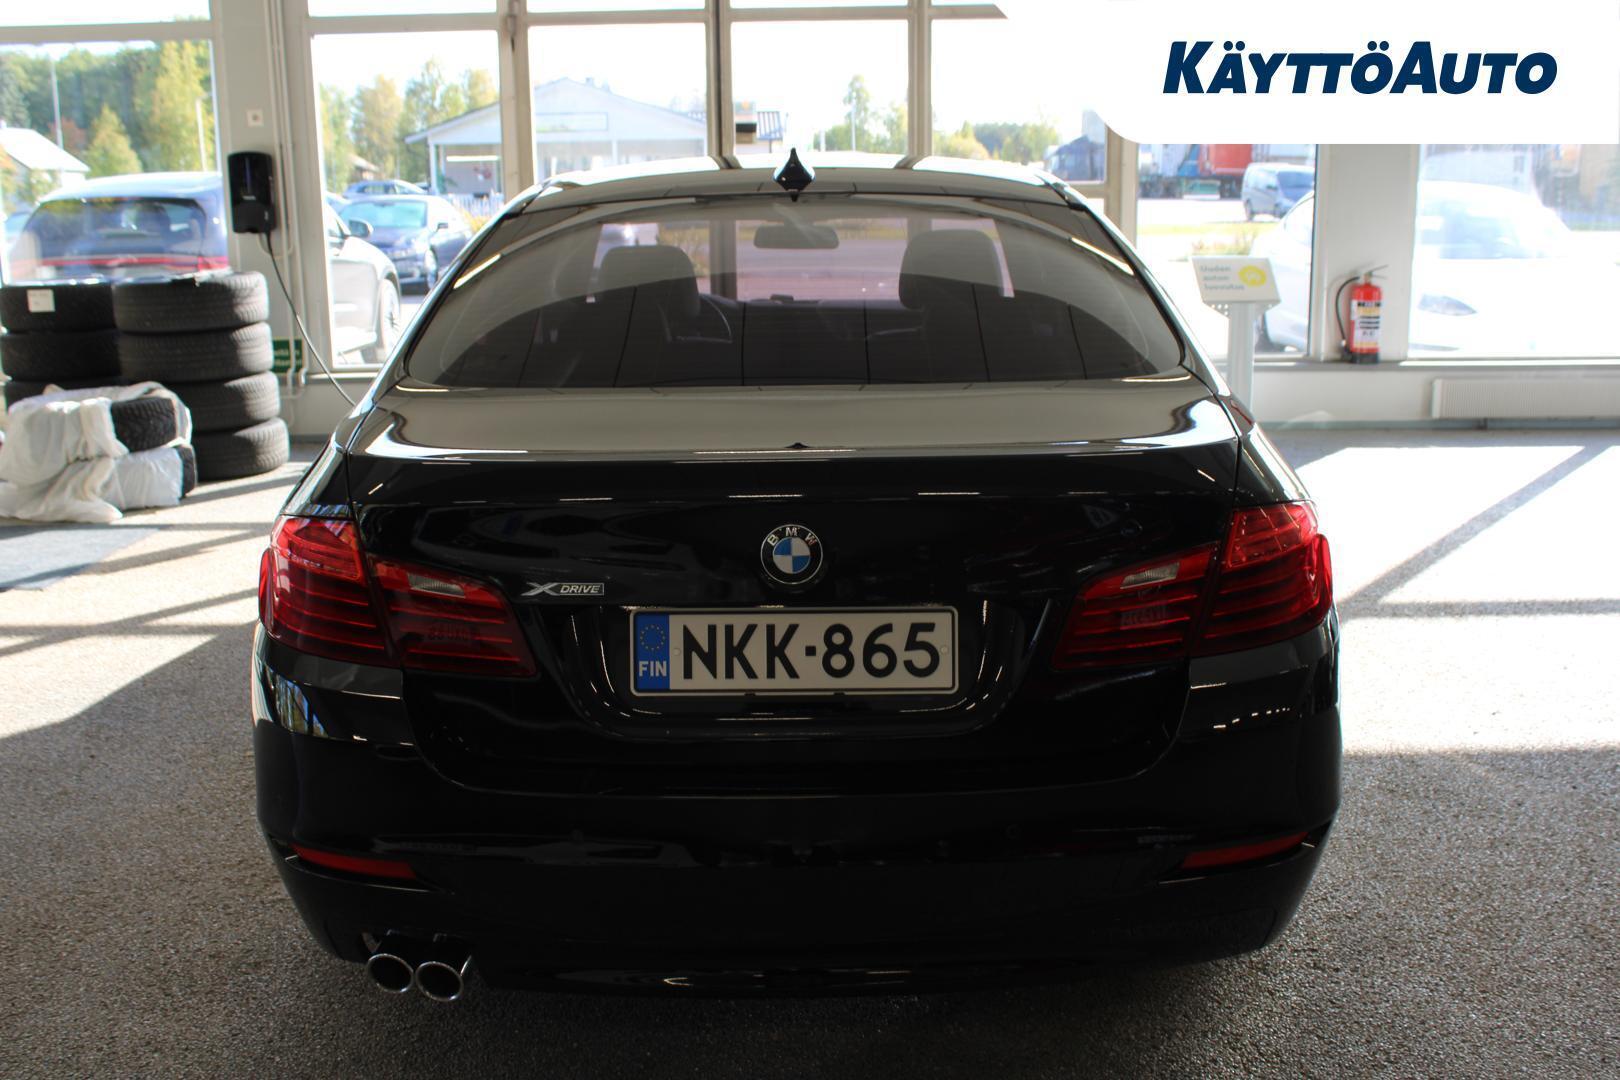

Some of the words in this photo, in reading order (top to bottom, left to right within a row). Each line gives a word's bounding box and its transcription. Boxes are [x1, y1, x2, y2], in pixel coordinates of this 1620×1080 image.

[767, 527, 817, 546] BMW
[682, 622, 940, 680] NKK-865
[639, 660, 667, 677] FIN
